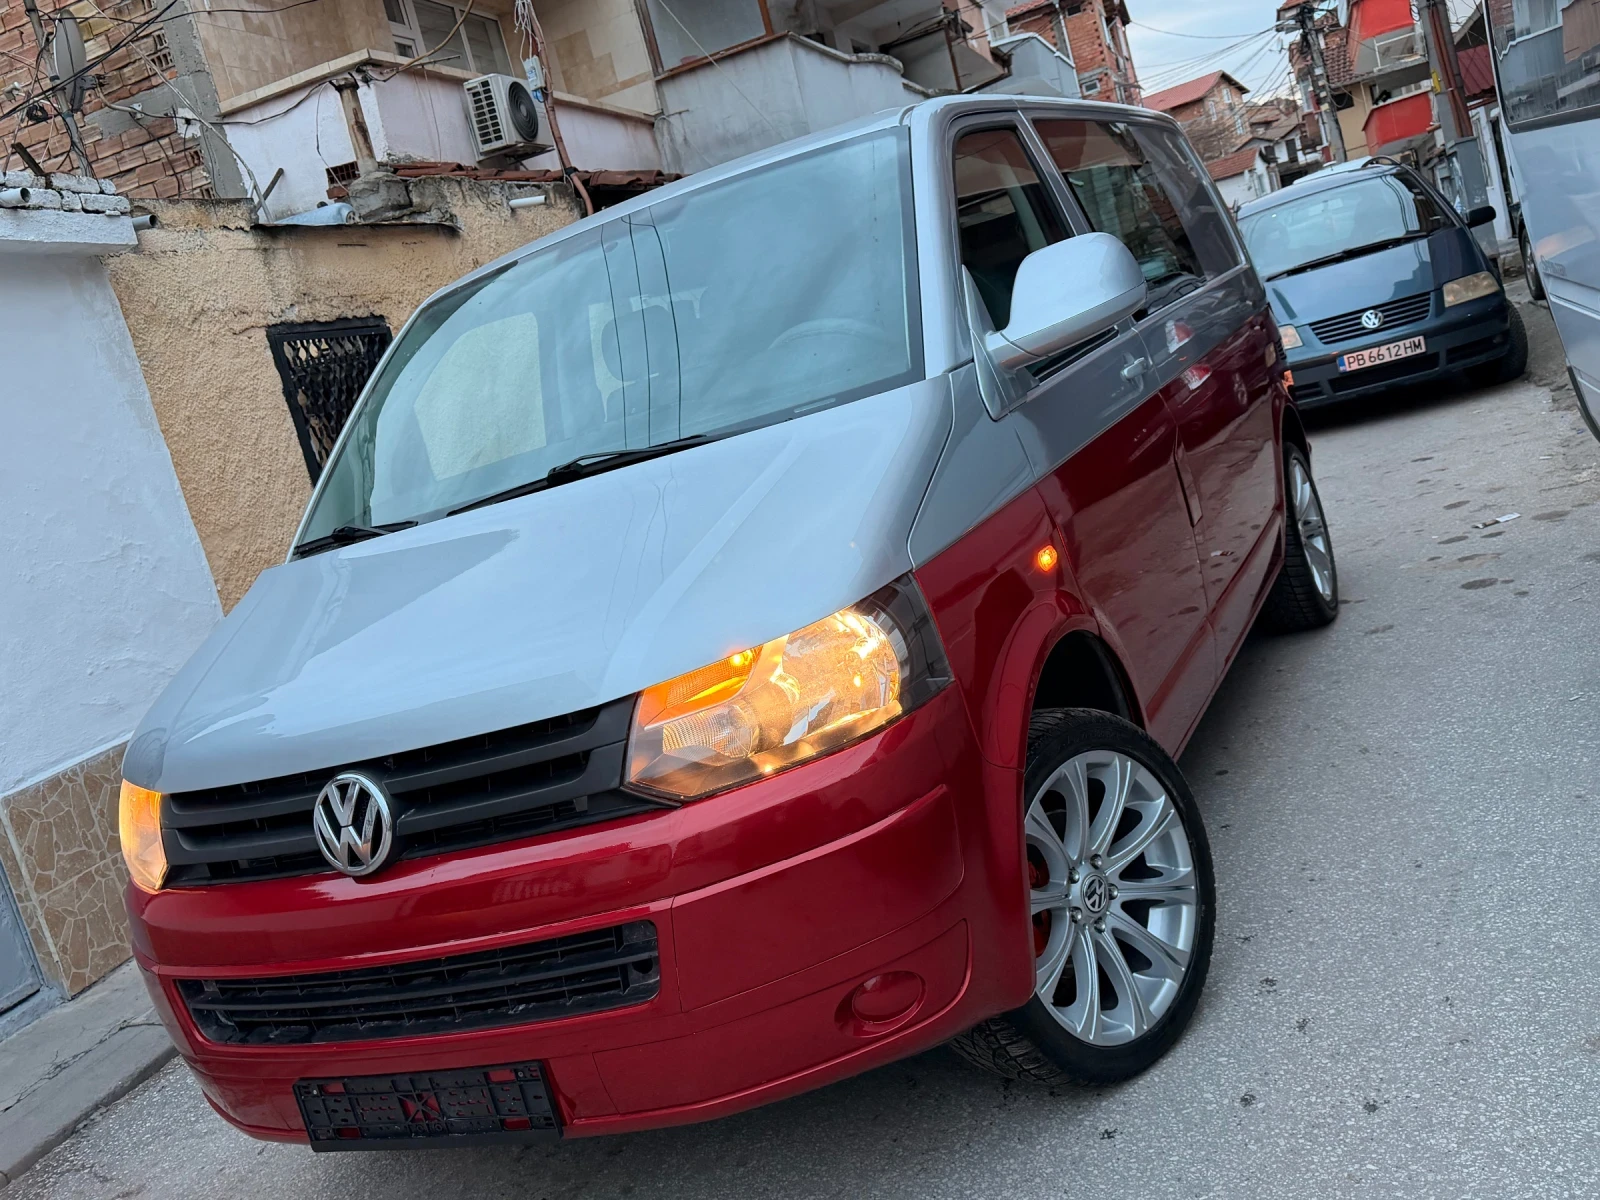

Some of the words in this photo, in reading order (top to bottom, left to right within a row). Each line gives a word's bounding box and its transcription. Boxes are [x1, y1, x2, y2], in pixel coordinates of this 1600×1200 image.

[1362, 310, 1383, 328] VW
[1346, 353, 1366, 368] PB
[1368, 344, 1402, 363] 6612
[1403, 338, 1423, 354] HM
[314, 773, 390, 874] VW
